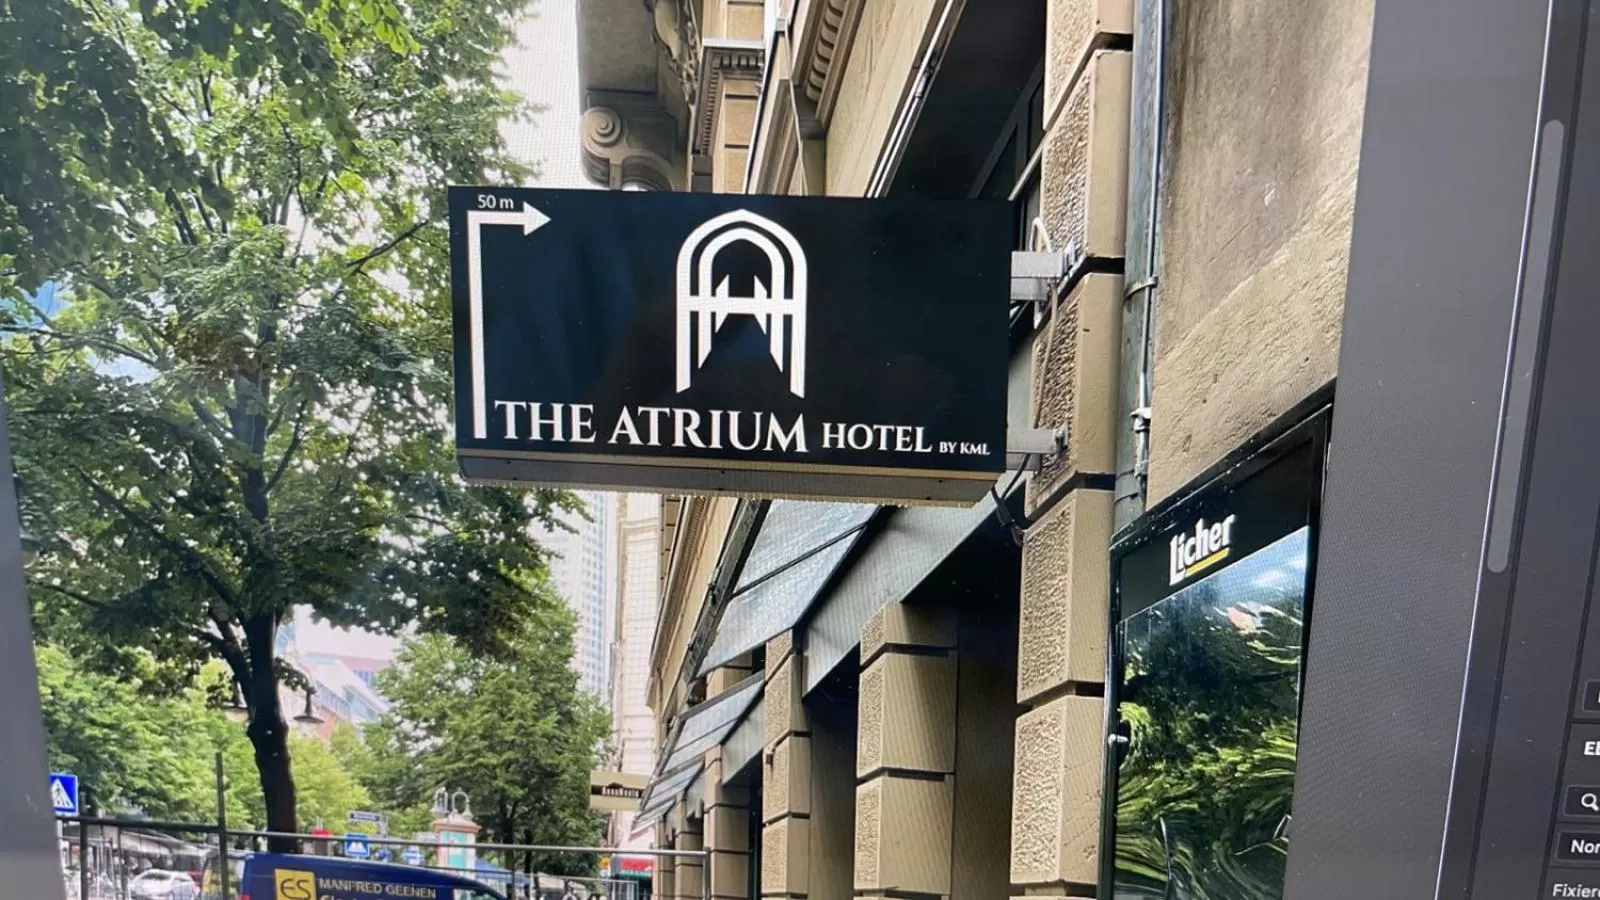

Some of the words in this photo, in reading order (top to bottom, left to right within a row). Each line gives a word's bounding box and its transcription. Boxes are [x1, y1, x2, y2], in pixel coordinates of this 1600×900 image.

[478, 194, 497, 209] 50
[499, 197, 514, 209] m
[494, 400, 597, 442] THE
[608, 405, 810, 453] ATRIUM
[821, 422, 932, 453] HOTEL
[939, 441, 957, 453] BY
[960, 442, 990, 455] KML
[1169, 513, 1235, 586] Licher
[280, 878, 312, 900] ES
[319, 878, 383, 894] MANFRED
[385, 883, 436, 898] GEENEN
